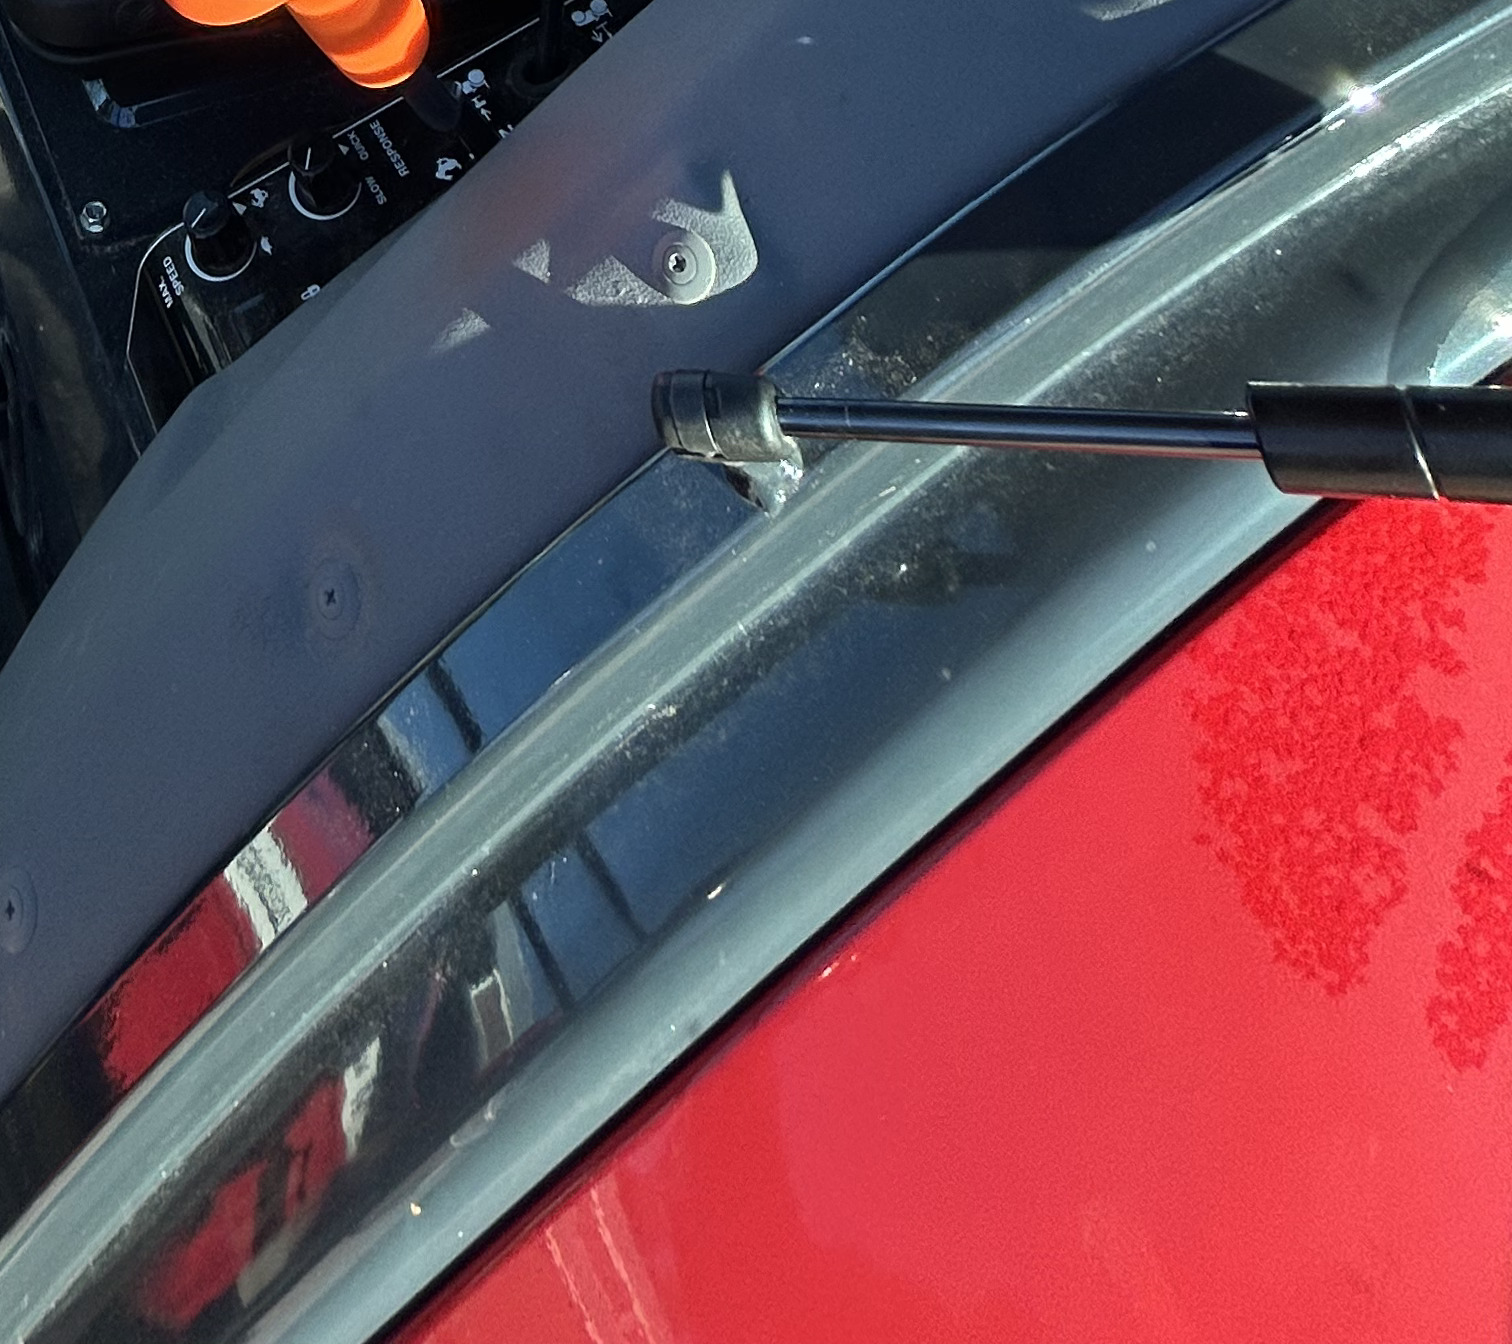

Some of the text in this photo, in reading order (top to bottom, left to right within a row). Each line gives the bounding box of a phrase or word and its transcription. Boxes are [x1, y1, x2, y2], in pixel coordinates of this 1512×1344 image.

[347, 130, 388, 206] SLOW QUICK
[369, 119, 410, 178] RESPONSE
[162, 255, 185, 297] SPEED
